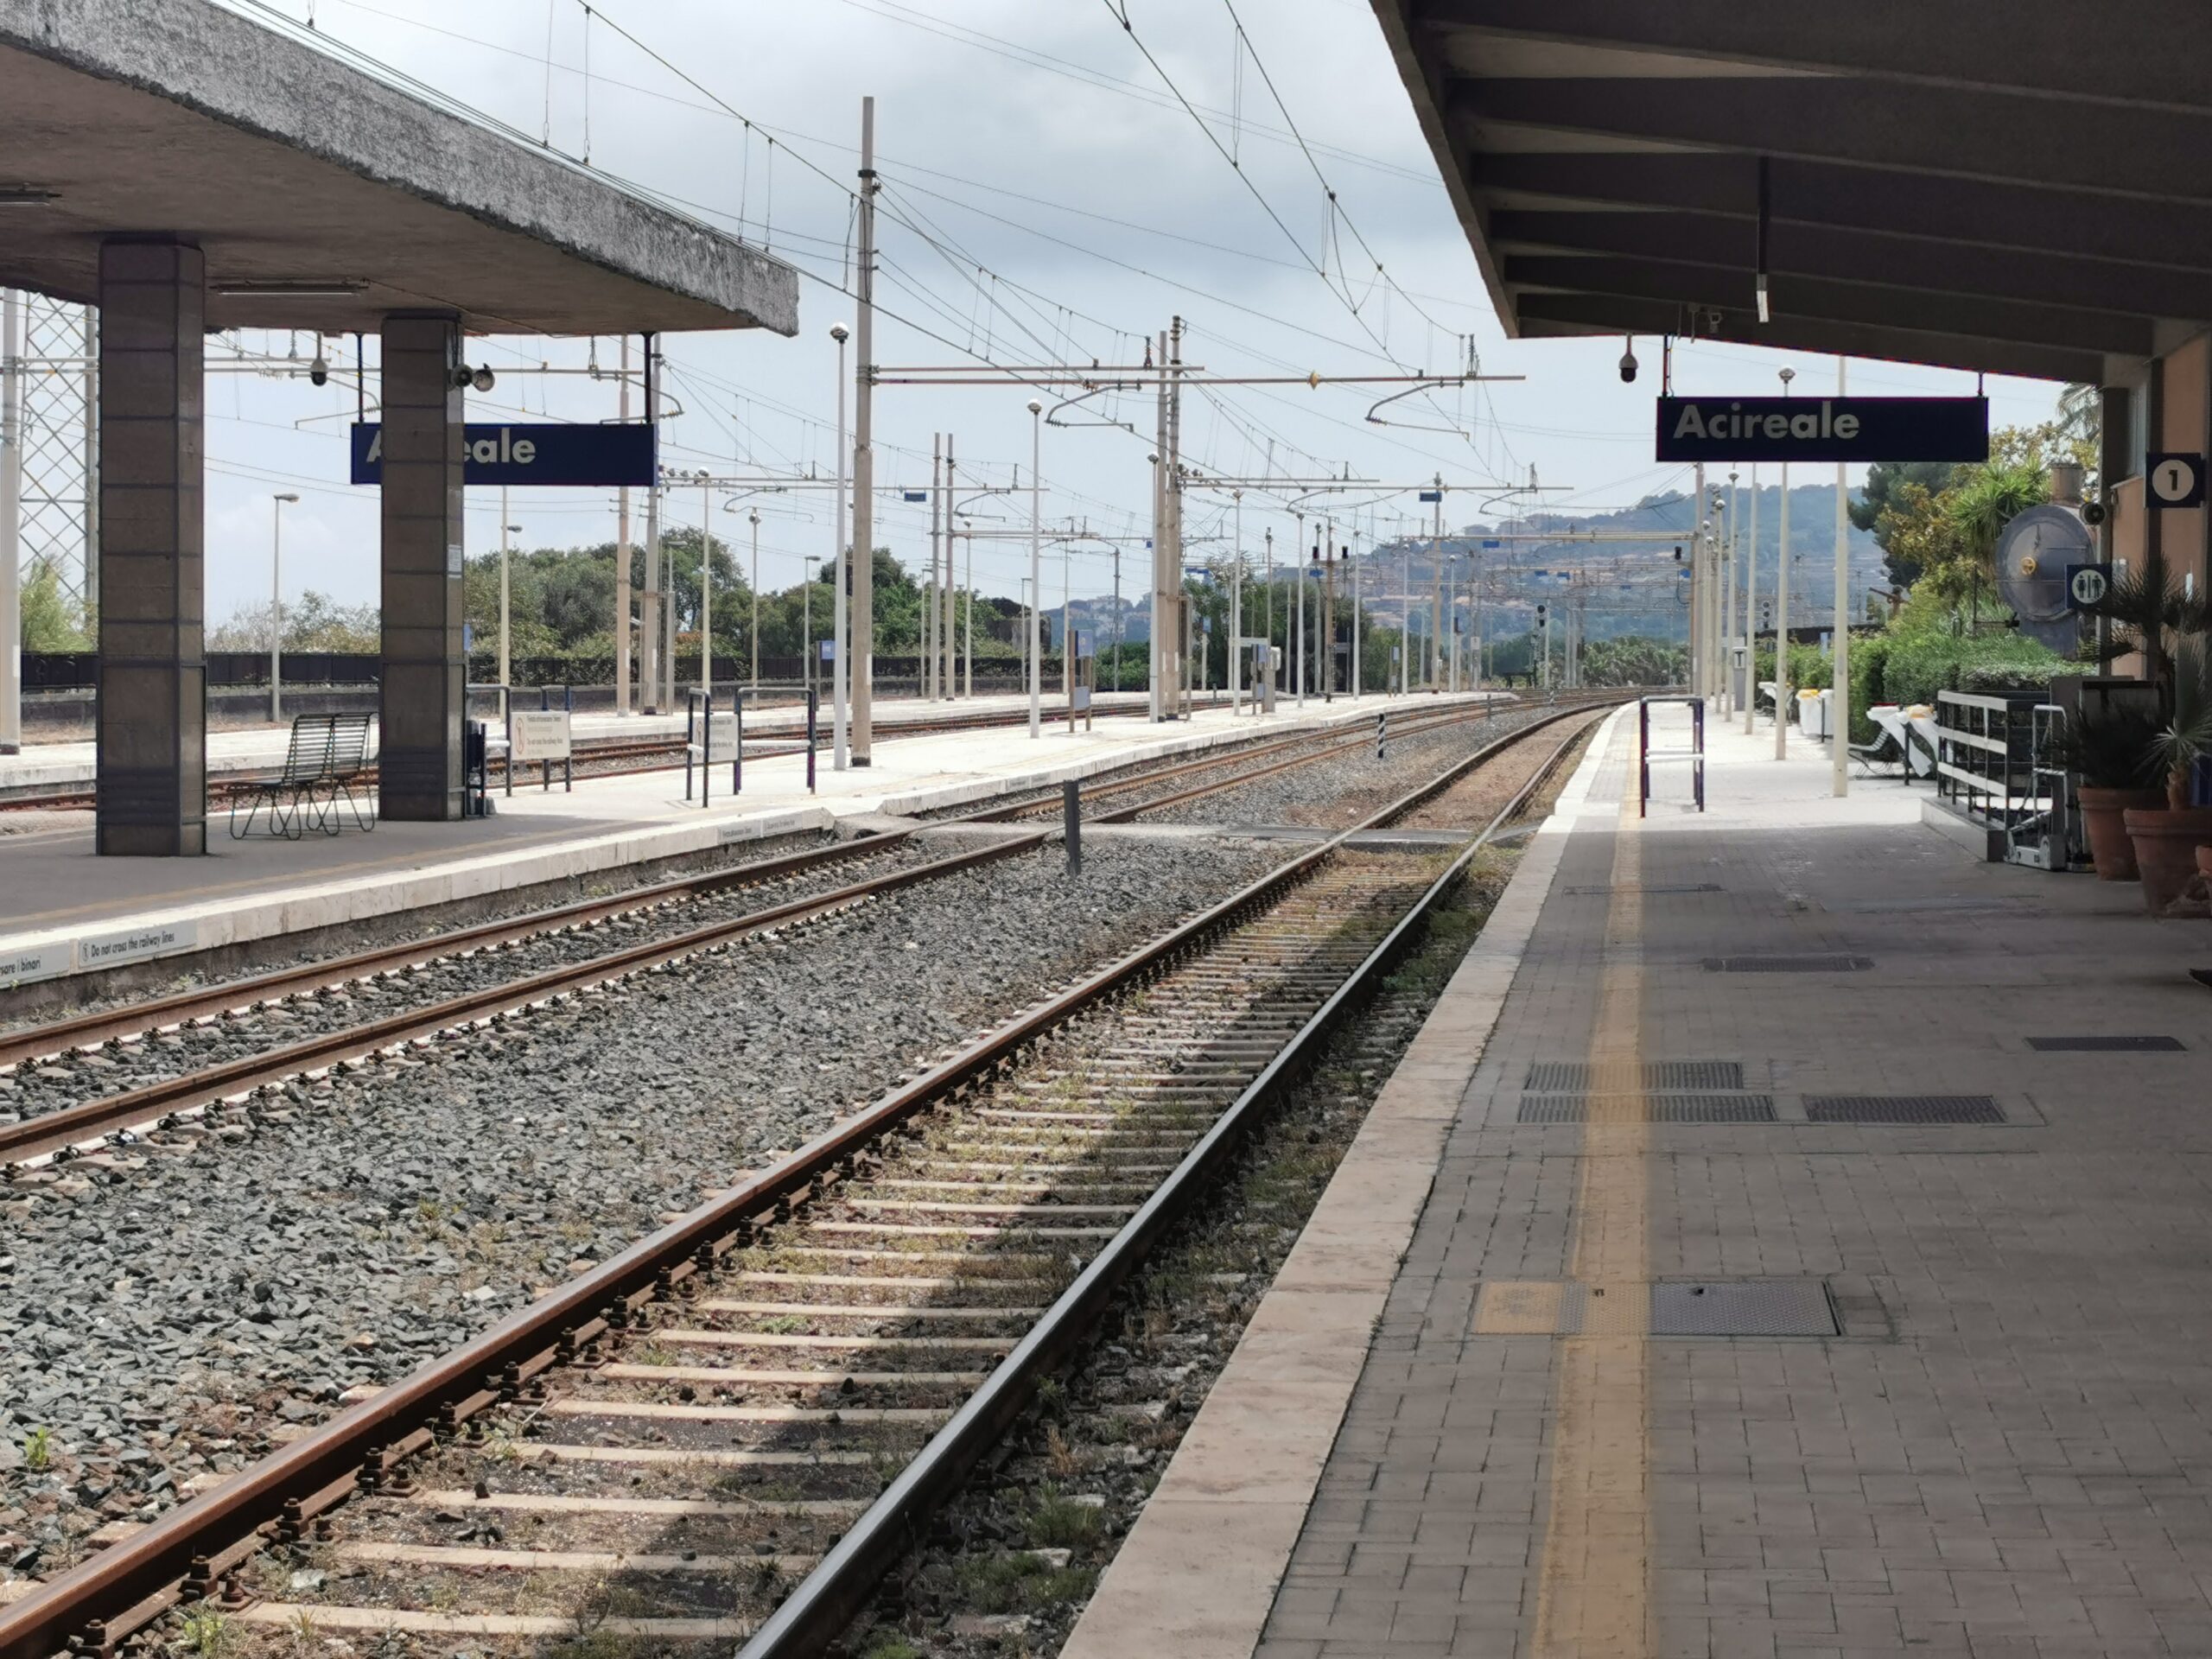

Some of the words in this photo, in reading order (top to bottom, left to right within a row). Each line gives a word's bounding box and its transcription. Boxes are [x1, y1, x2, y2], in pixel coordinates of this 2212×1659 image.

[1673, 400, 1859, 439] Acireale
[2169, 469, 2177, 491] 1
[1735, 652, 1744, 665] T
[91, 944, 99, 957] Do
[101, 943, 111, 955] not
[111, 942, 127, 954] cross
[128, 937, 138, 950] the
[139, 933, 161, 948] railway
[162, 931, 175, 944] lines
[21, 955, 41, 971] binari
